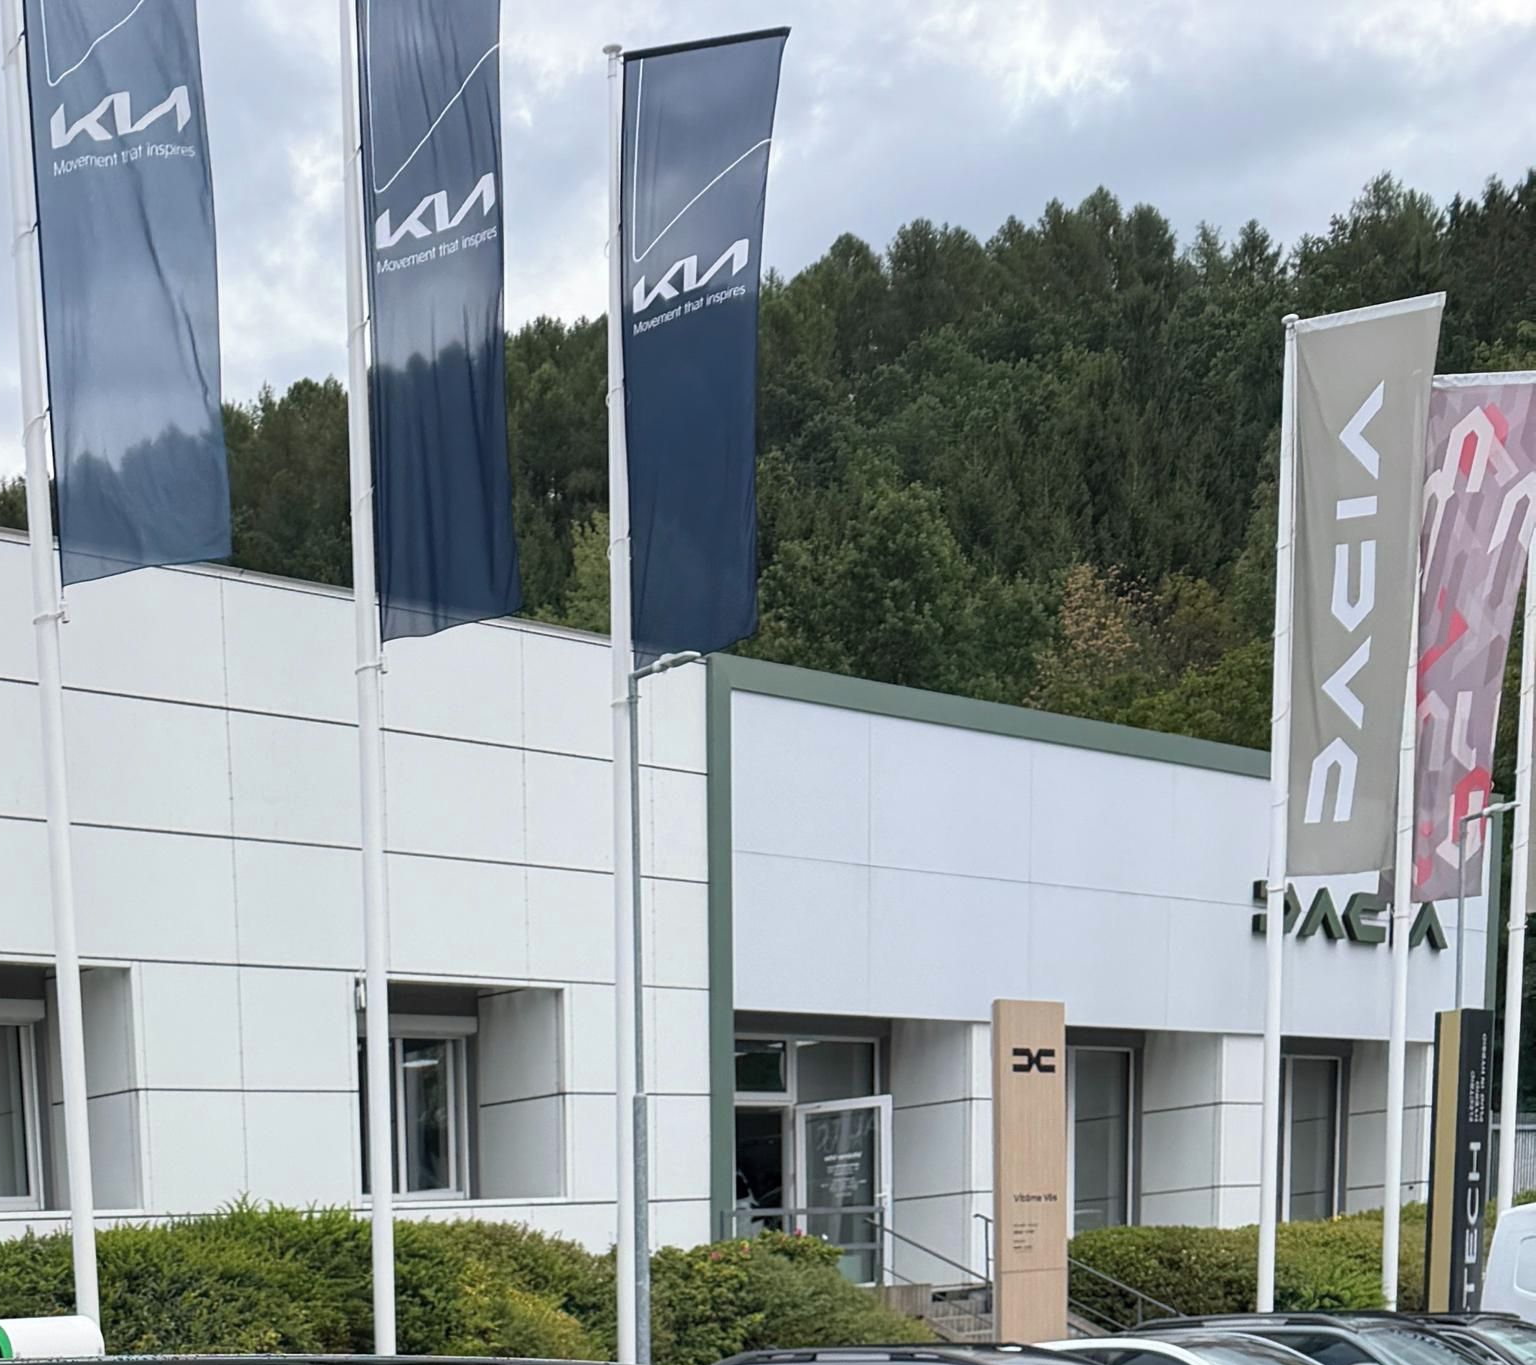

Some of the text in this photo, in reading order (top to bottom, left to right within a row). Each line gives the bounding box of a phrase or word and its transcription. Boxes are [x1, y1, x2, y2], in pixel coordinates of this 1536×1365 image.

[50, 85, 191, 149] KIA
[53, 142, 197, 177] Movement that inspires
[375, 172, 496, 250] KIA
[376, 225, 498, 275] Movement that inspires
[632, 238, 750, 315] KIA
[633, 284, 747, 336] Movement that inspires
